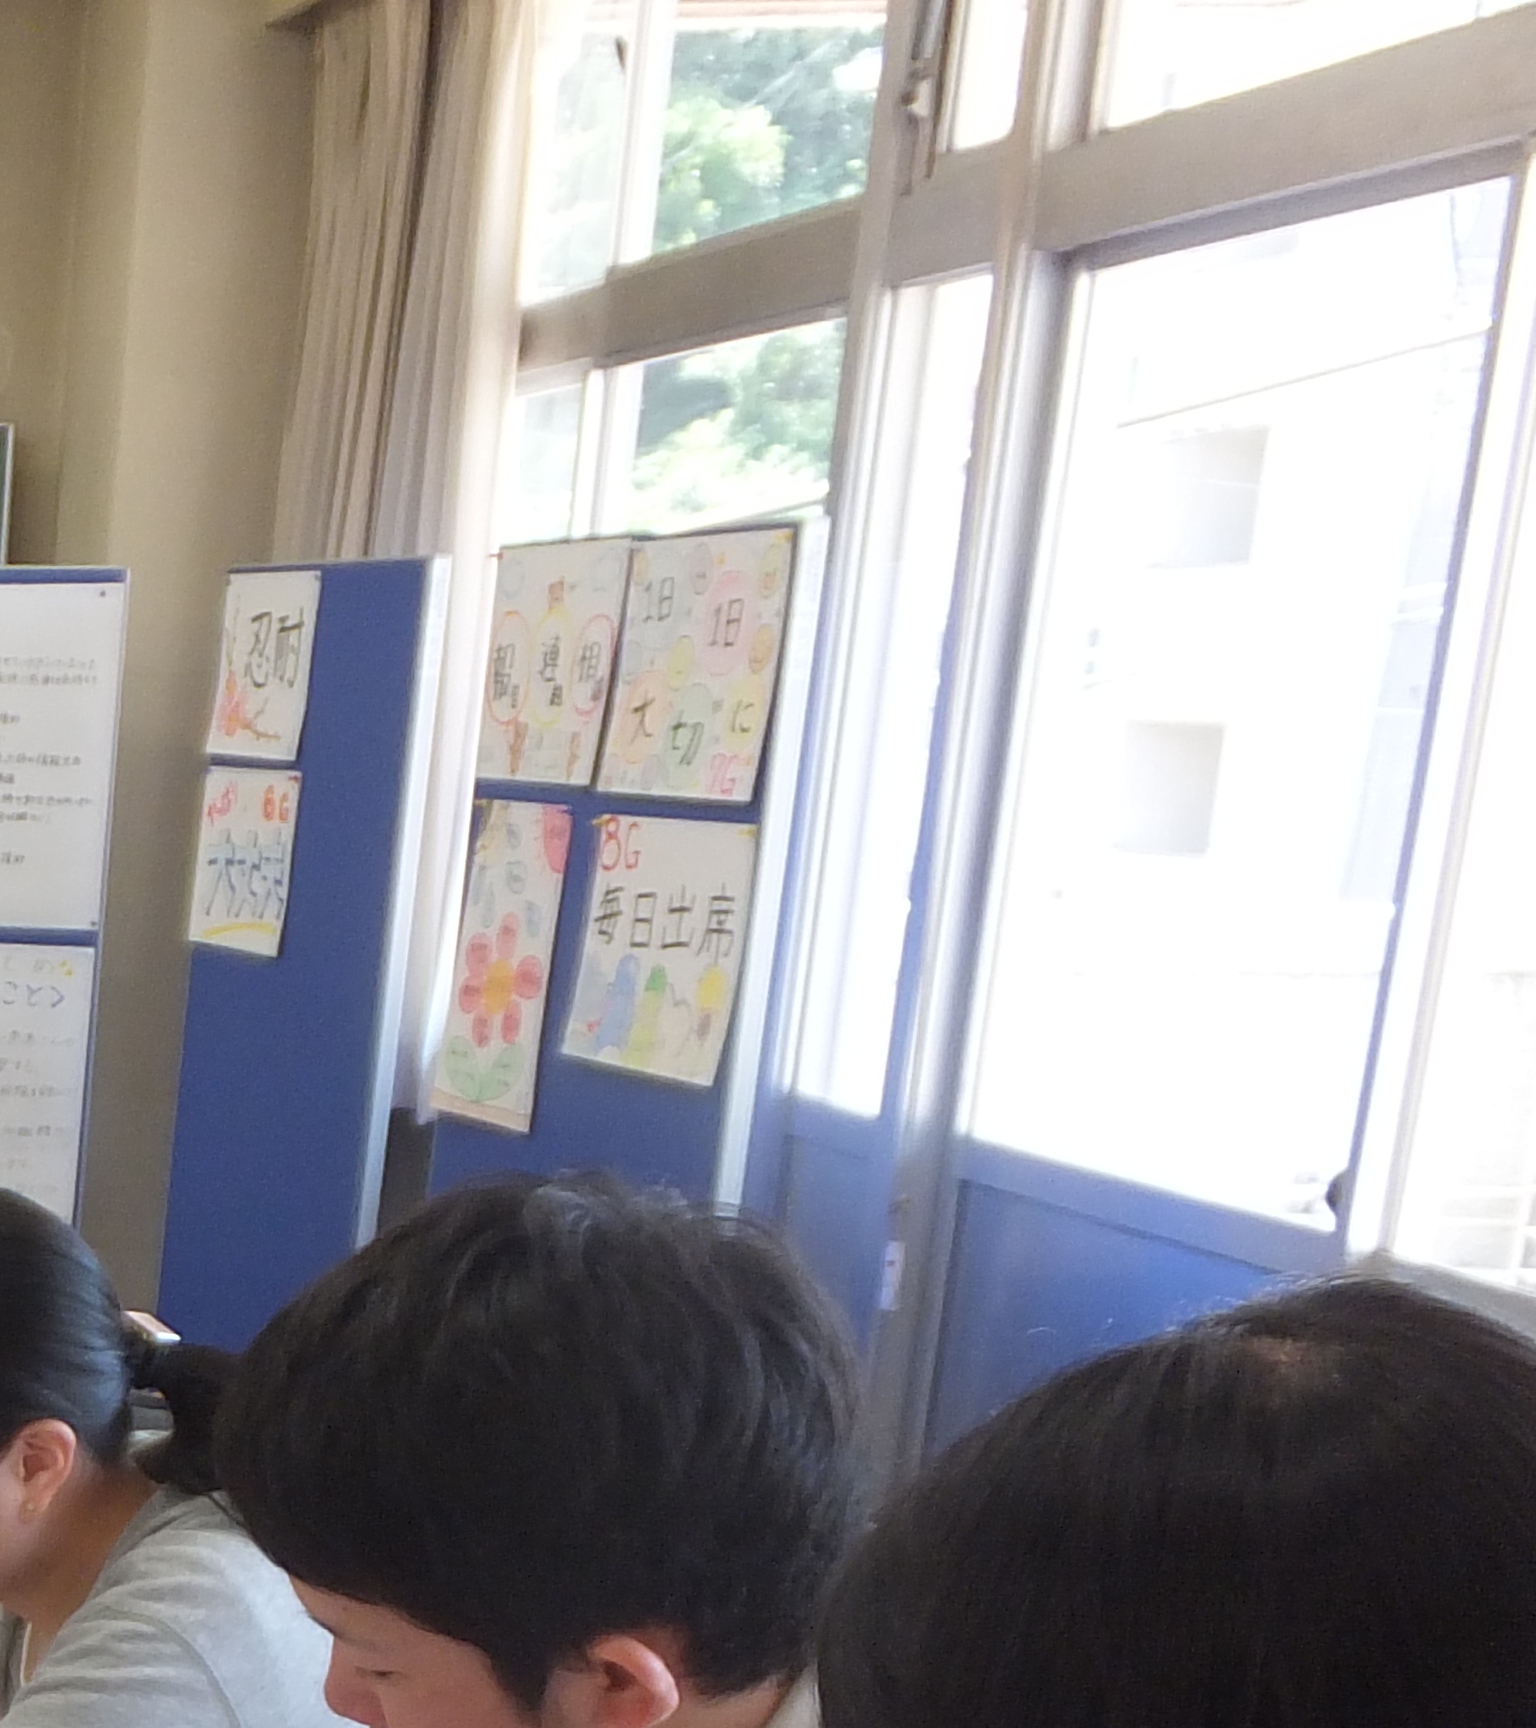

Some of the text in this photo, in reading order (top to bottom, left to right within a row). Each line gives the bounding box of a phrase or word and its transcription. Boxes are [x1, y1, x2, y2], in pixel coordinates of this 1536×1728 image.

[244, 608, 305, 690] 忍耐
[598, 814, 642, 872] 8G
[593, 882, 737, 967] 毎日出席
